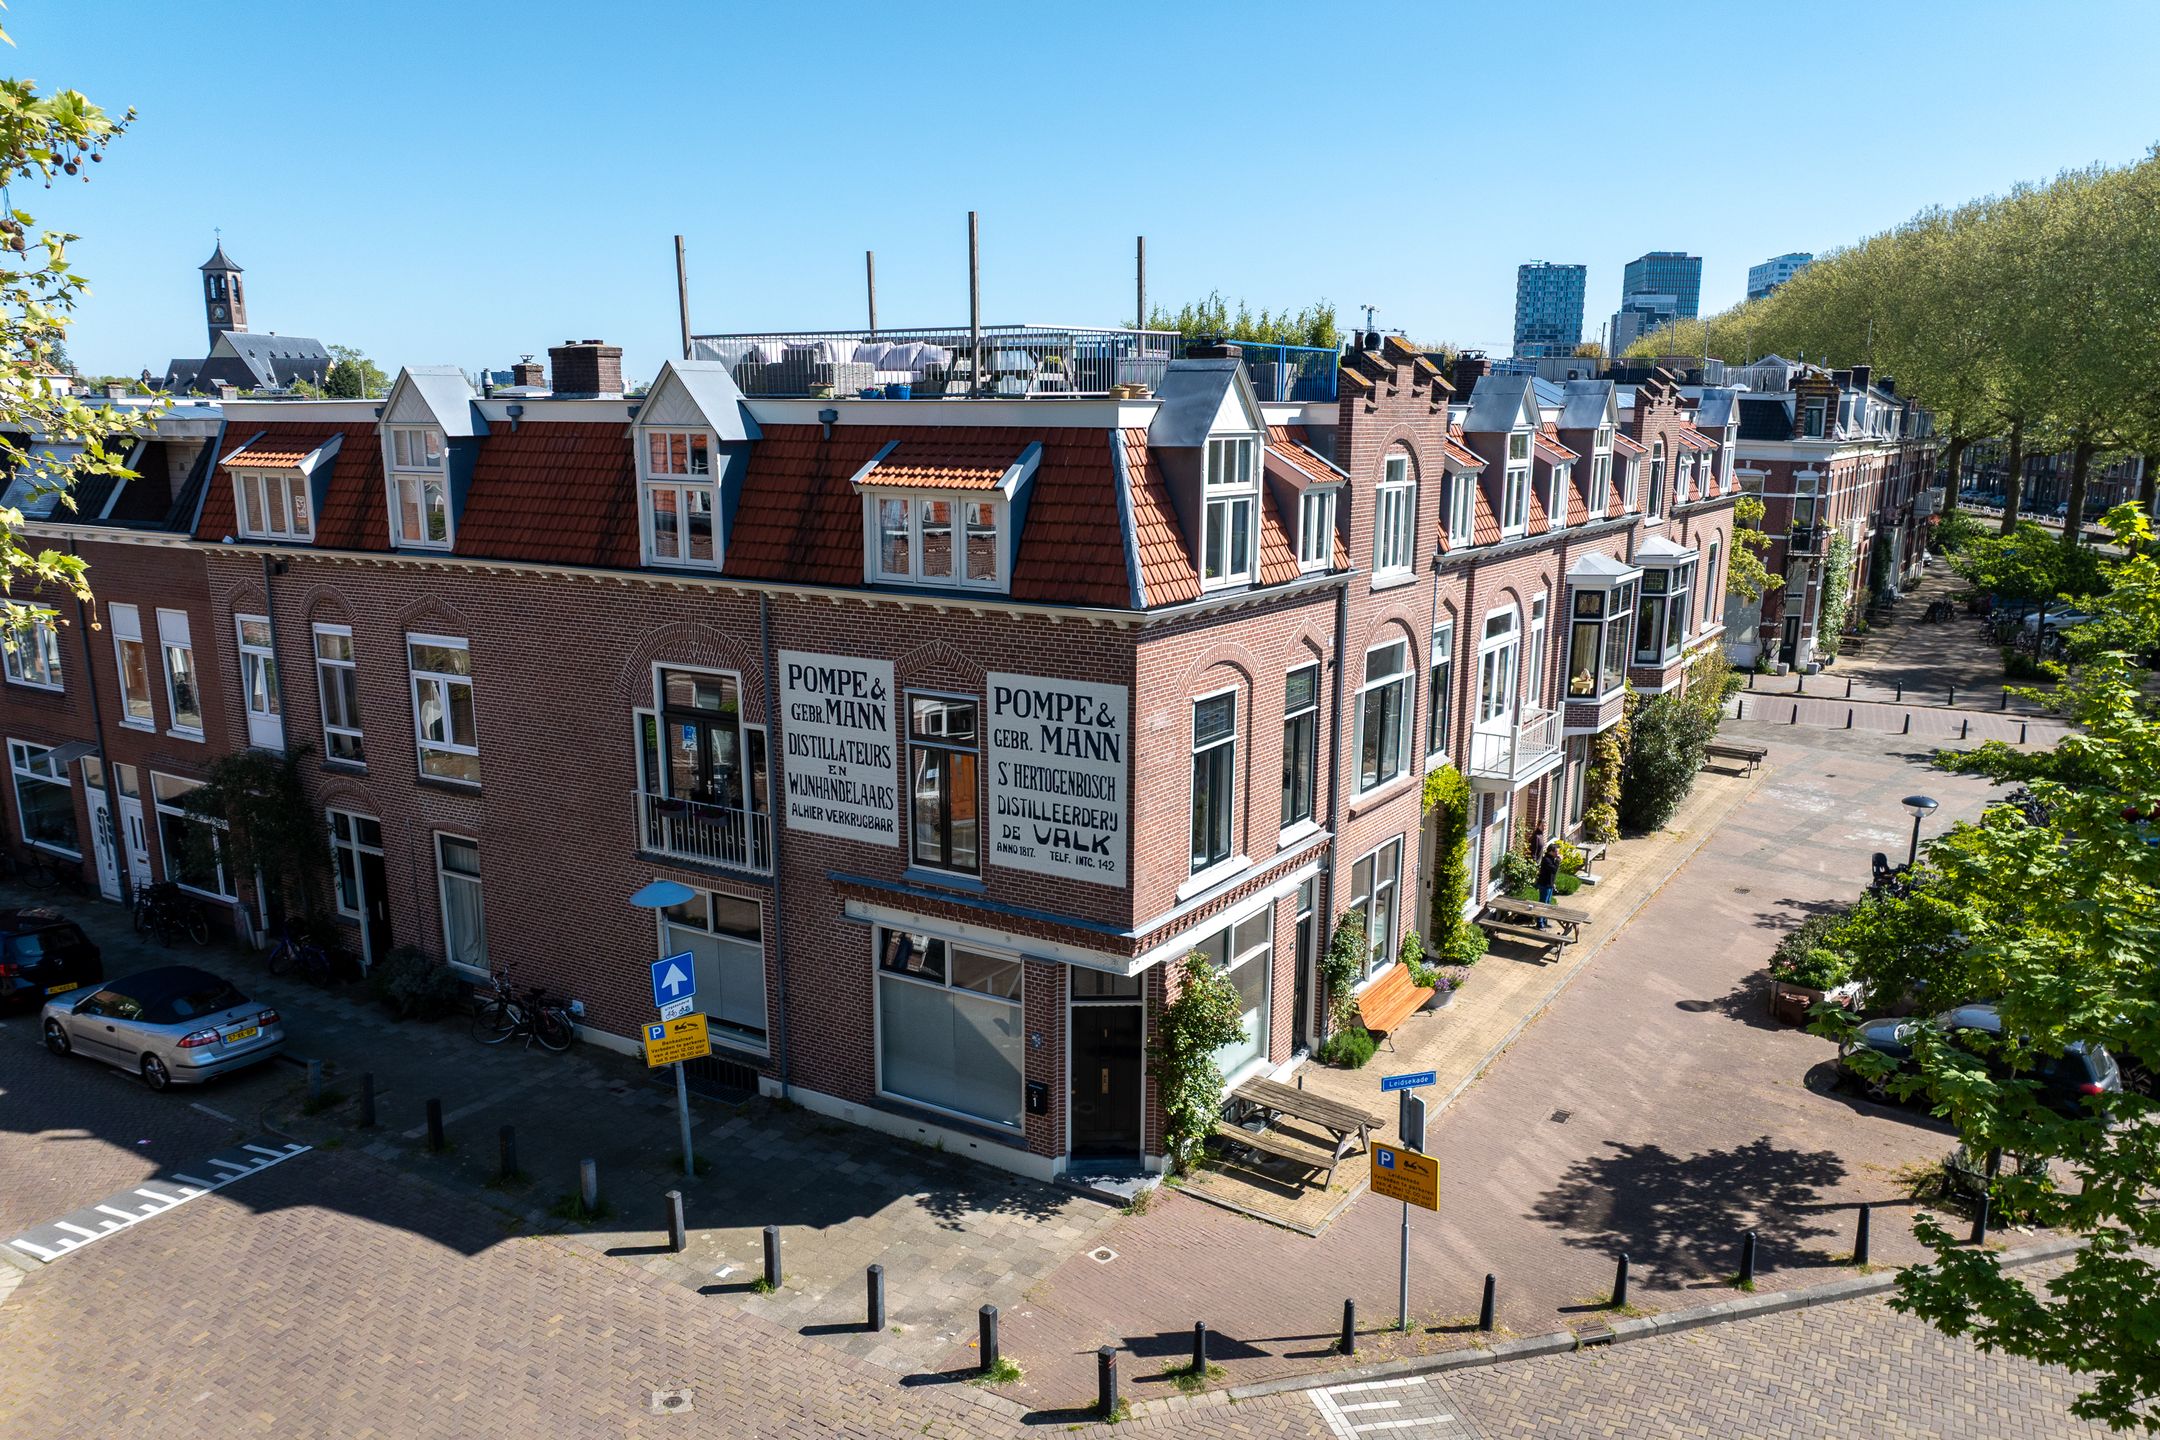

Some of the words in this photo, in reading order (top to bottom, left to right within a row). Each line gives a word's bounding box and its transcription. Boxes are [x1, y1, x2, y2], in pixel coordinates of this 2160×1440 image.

[788, 664, 868, 699] POMPE
[791, 702, 825, 725] GEBR.
[825, 698, 886, 732] MANN
[994, 686, 1093, 726] POMPE
[788, 733, 891, 769] DISTILLATEURS
[994, 728, 1033, 751] GEBR.
[1040, 724, 1121, 763] MANN
[828, 765, 847, 776] EN
[788, 772, 894, 810] WIJNHANDELAARS
[792, 803, 824, 821] ALHIER
[825, 809, 893, 832] VERKRIJGBAAR
[998, 795, 1118, 832] DISTILLEERDERIJ
[1002, 824, 1021, 841] DE
[1033, 824, 1111, 856] VALK
[996, 842, 1018, 855] ANNO
[1050, 850, 1071, 864] TELF.
[1098, 859, 1115, 872] 142
[652, 1027, 662, 1039] P
[1389, 1076, 1429, 1088] Leidsekade
[1381, 1151, 1391, 1165] P
